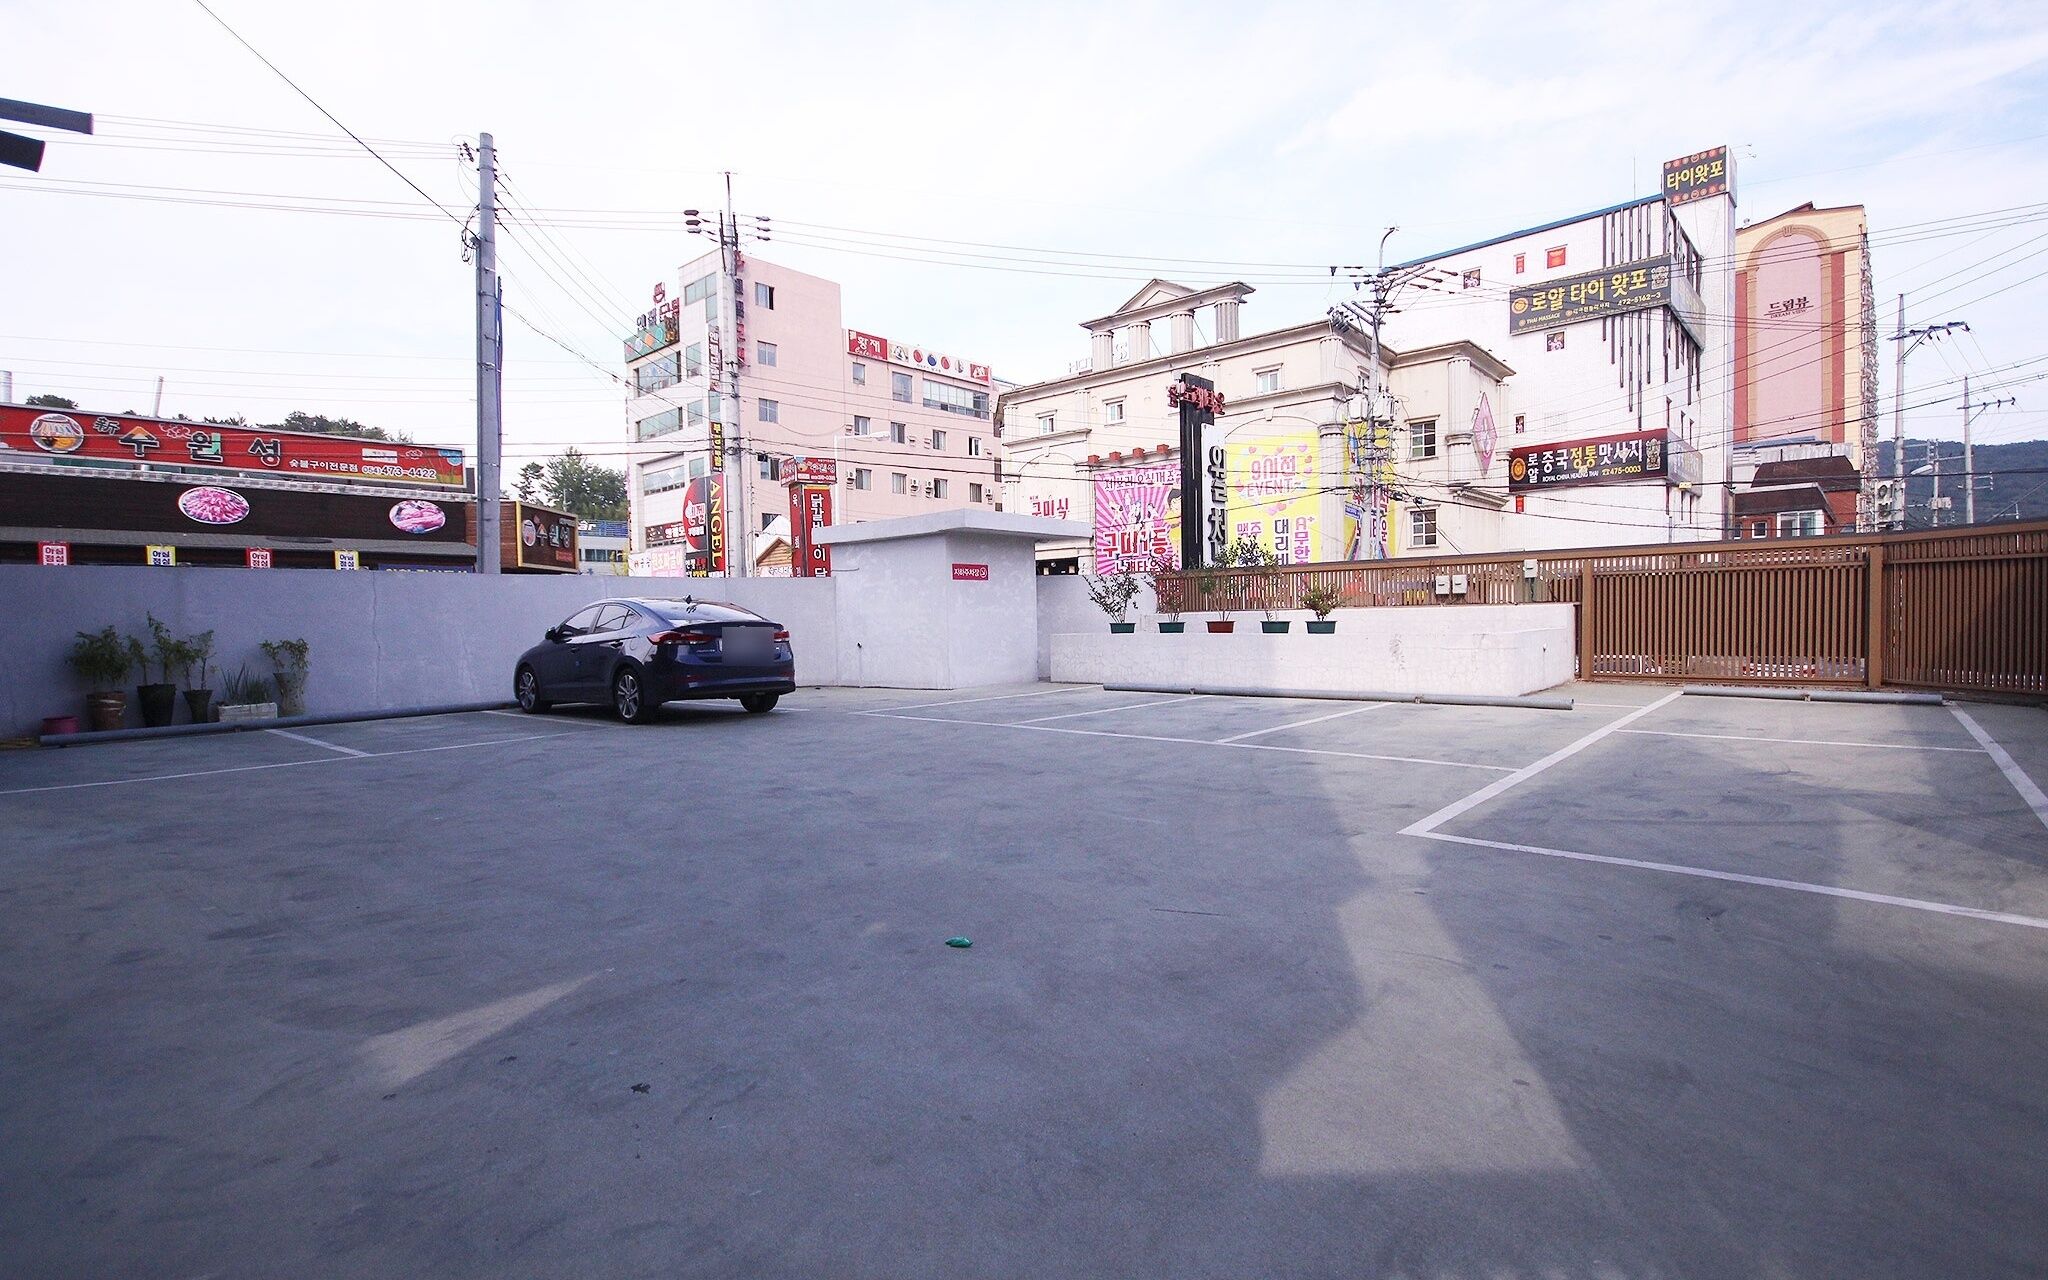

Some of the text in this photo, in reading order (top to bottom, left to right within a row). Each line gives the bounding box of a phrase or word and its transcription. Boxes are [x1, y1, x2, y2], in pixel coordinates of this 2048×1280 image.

[1666, 159, 1724, 192] 타이왓포
[1530, 269, 1648, 312] 로얄 타이 왓포
[1768, 296, 1810, 312] 드림뷰
[93, 416, 120, 437] 新
[1527, 453, 1538, 484] 로얄
[1247, 478, 1293, 498] EVENT
[710, 479, 723, 568] ANGEL
